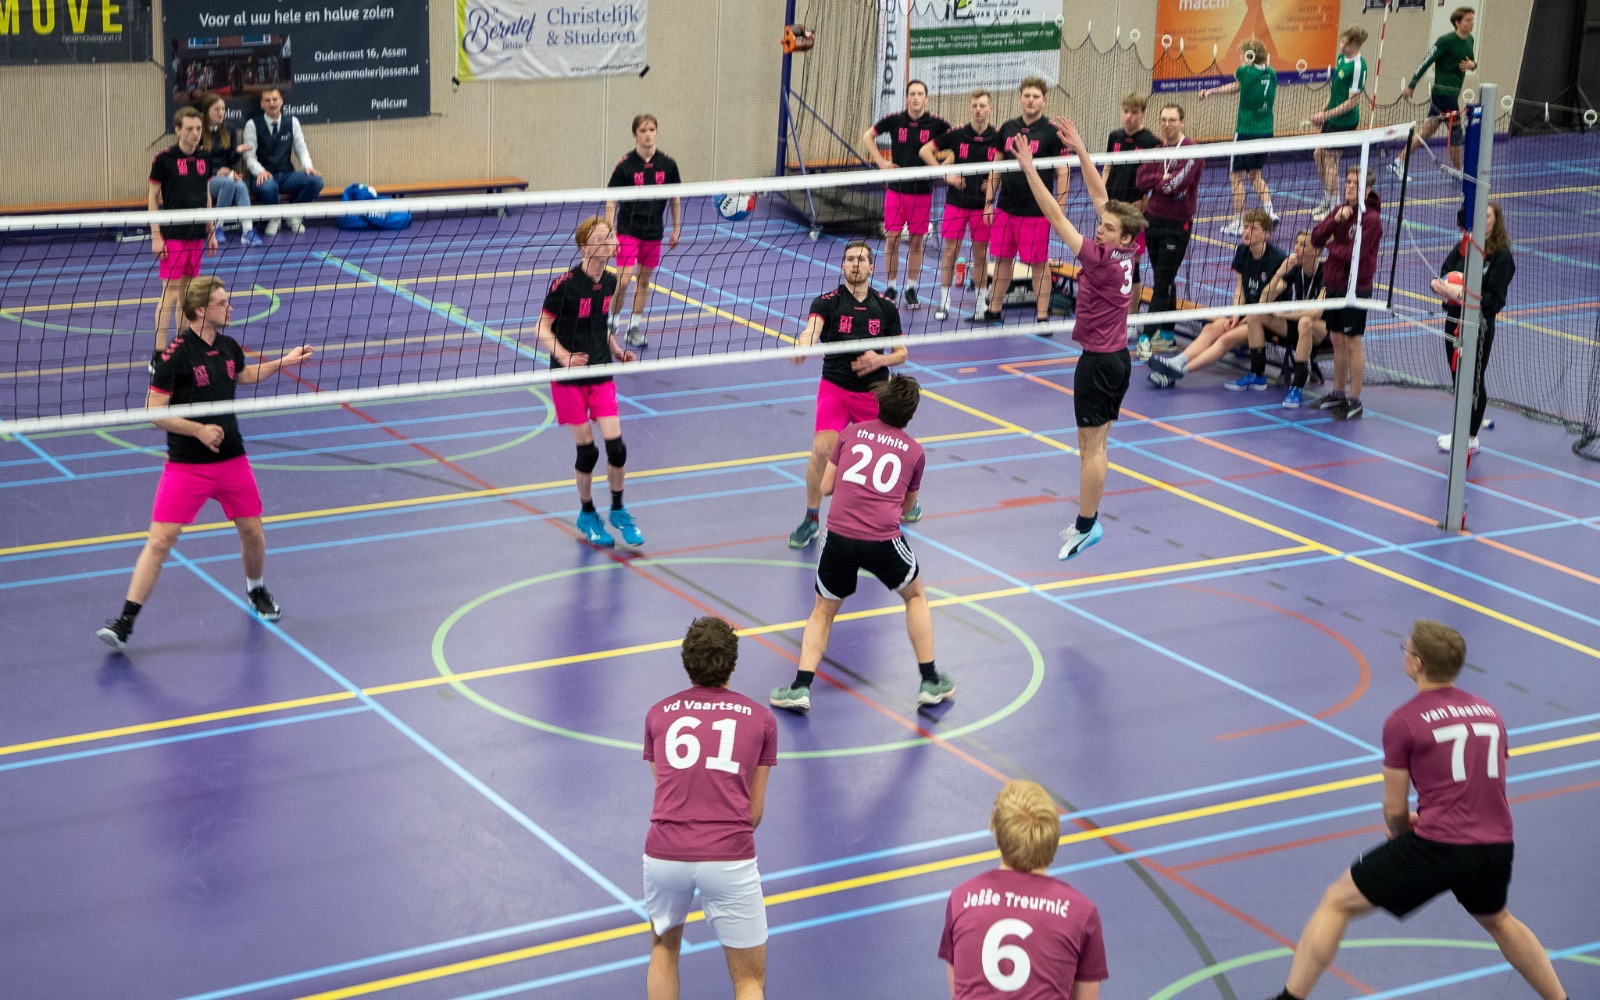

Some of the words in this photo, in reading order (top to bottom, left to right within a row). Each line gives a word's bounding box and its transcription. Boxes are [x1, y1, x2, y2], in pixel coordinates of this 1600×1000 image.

[200, 12, 230, 27] Voor
[233, 10, 247, 26] al
[250, 12, 271, 25] uw
[274, 8, 301, 24] hele
[305, 10, 320, 22] en
[324, 6, 359, 22] halve
[363, 5, 394, 20] zolen
[547, 4, 639, 25] Christelijk
[462, 7, 536, 54] Bernlef
[547, 31, 560, 46] &
[564, 28, 636, 46] Studeren
[314, 50, 364, 63] Oudestraat
[366, 48, 379, 60] 16,
[381, 46, 407, 58] Assen
[294, 64, 419, 83] www.schoenmakerijassen.nl
[1260, 79, 1271, 98] 7
[283, 102, 319, 116] Sleutels
[371, 97, 408, 110] Pedicure
[1119, 258, 1133, 296] 3
[857, 429, 875, 441] the
[877, 433, 909, 452] White
[842, 443, 902, 494] 20
[663, 699, 681, 713] vd
[684, 700, 752, 716] Vaartsen
[665, 716, 740, 775] 61
[1431, 722, 1500, 783] 77
[981, 917, 1034, 992] 6
